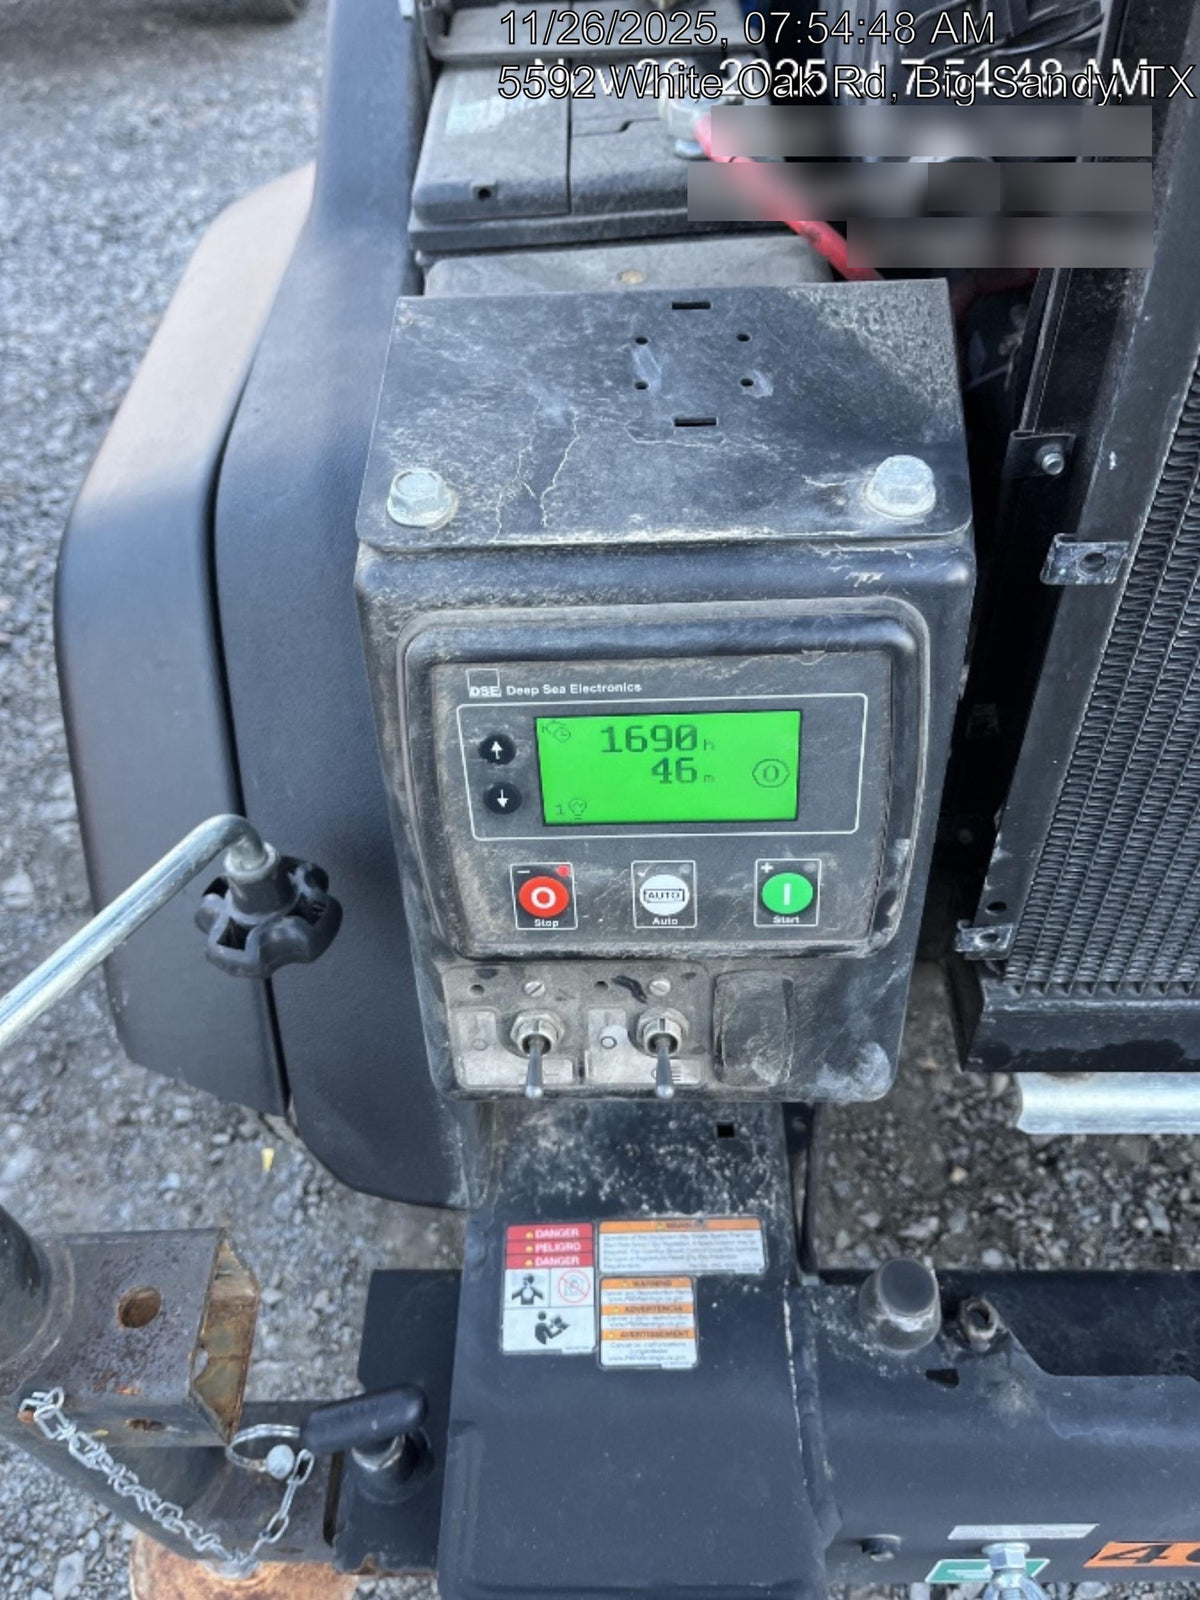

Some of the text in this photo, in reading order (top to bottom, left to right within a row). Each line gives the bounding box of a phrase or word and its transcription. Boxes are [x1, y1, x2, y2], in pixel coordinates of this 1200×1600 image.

[506, 685, 540, 697] Deep
[542, 684, 566, 695] Sea
[570, 682, 642, 694] Electronics
[601, 725, 698, 753] 1690
[651, 757, 698, 784] 46
[534, 918, 559, 929] Stop
[652, 916, 679, 926] Auto
[772, 915, 800, 924] Start
[535, 1228, 579, 1239] DANGER
[535, 1241, 582, 1253] PELIGRO
[535, 1255, 580, 1267] DANGER
